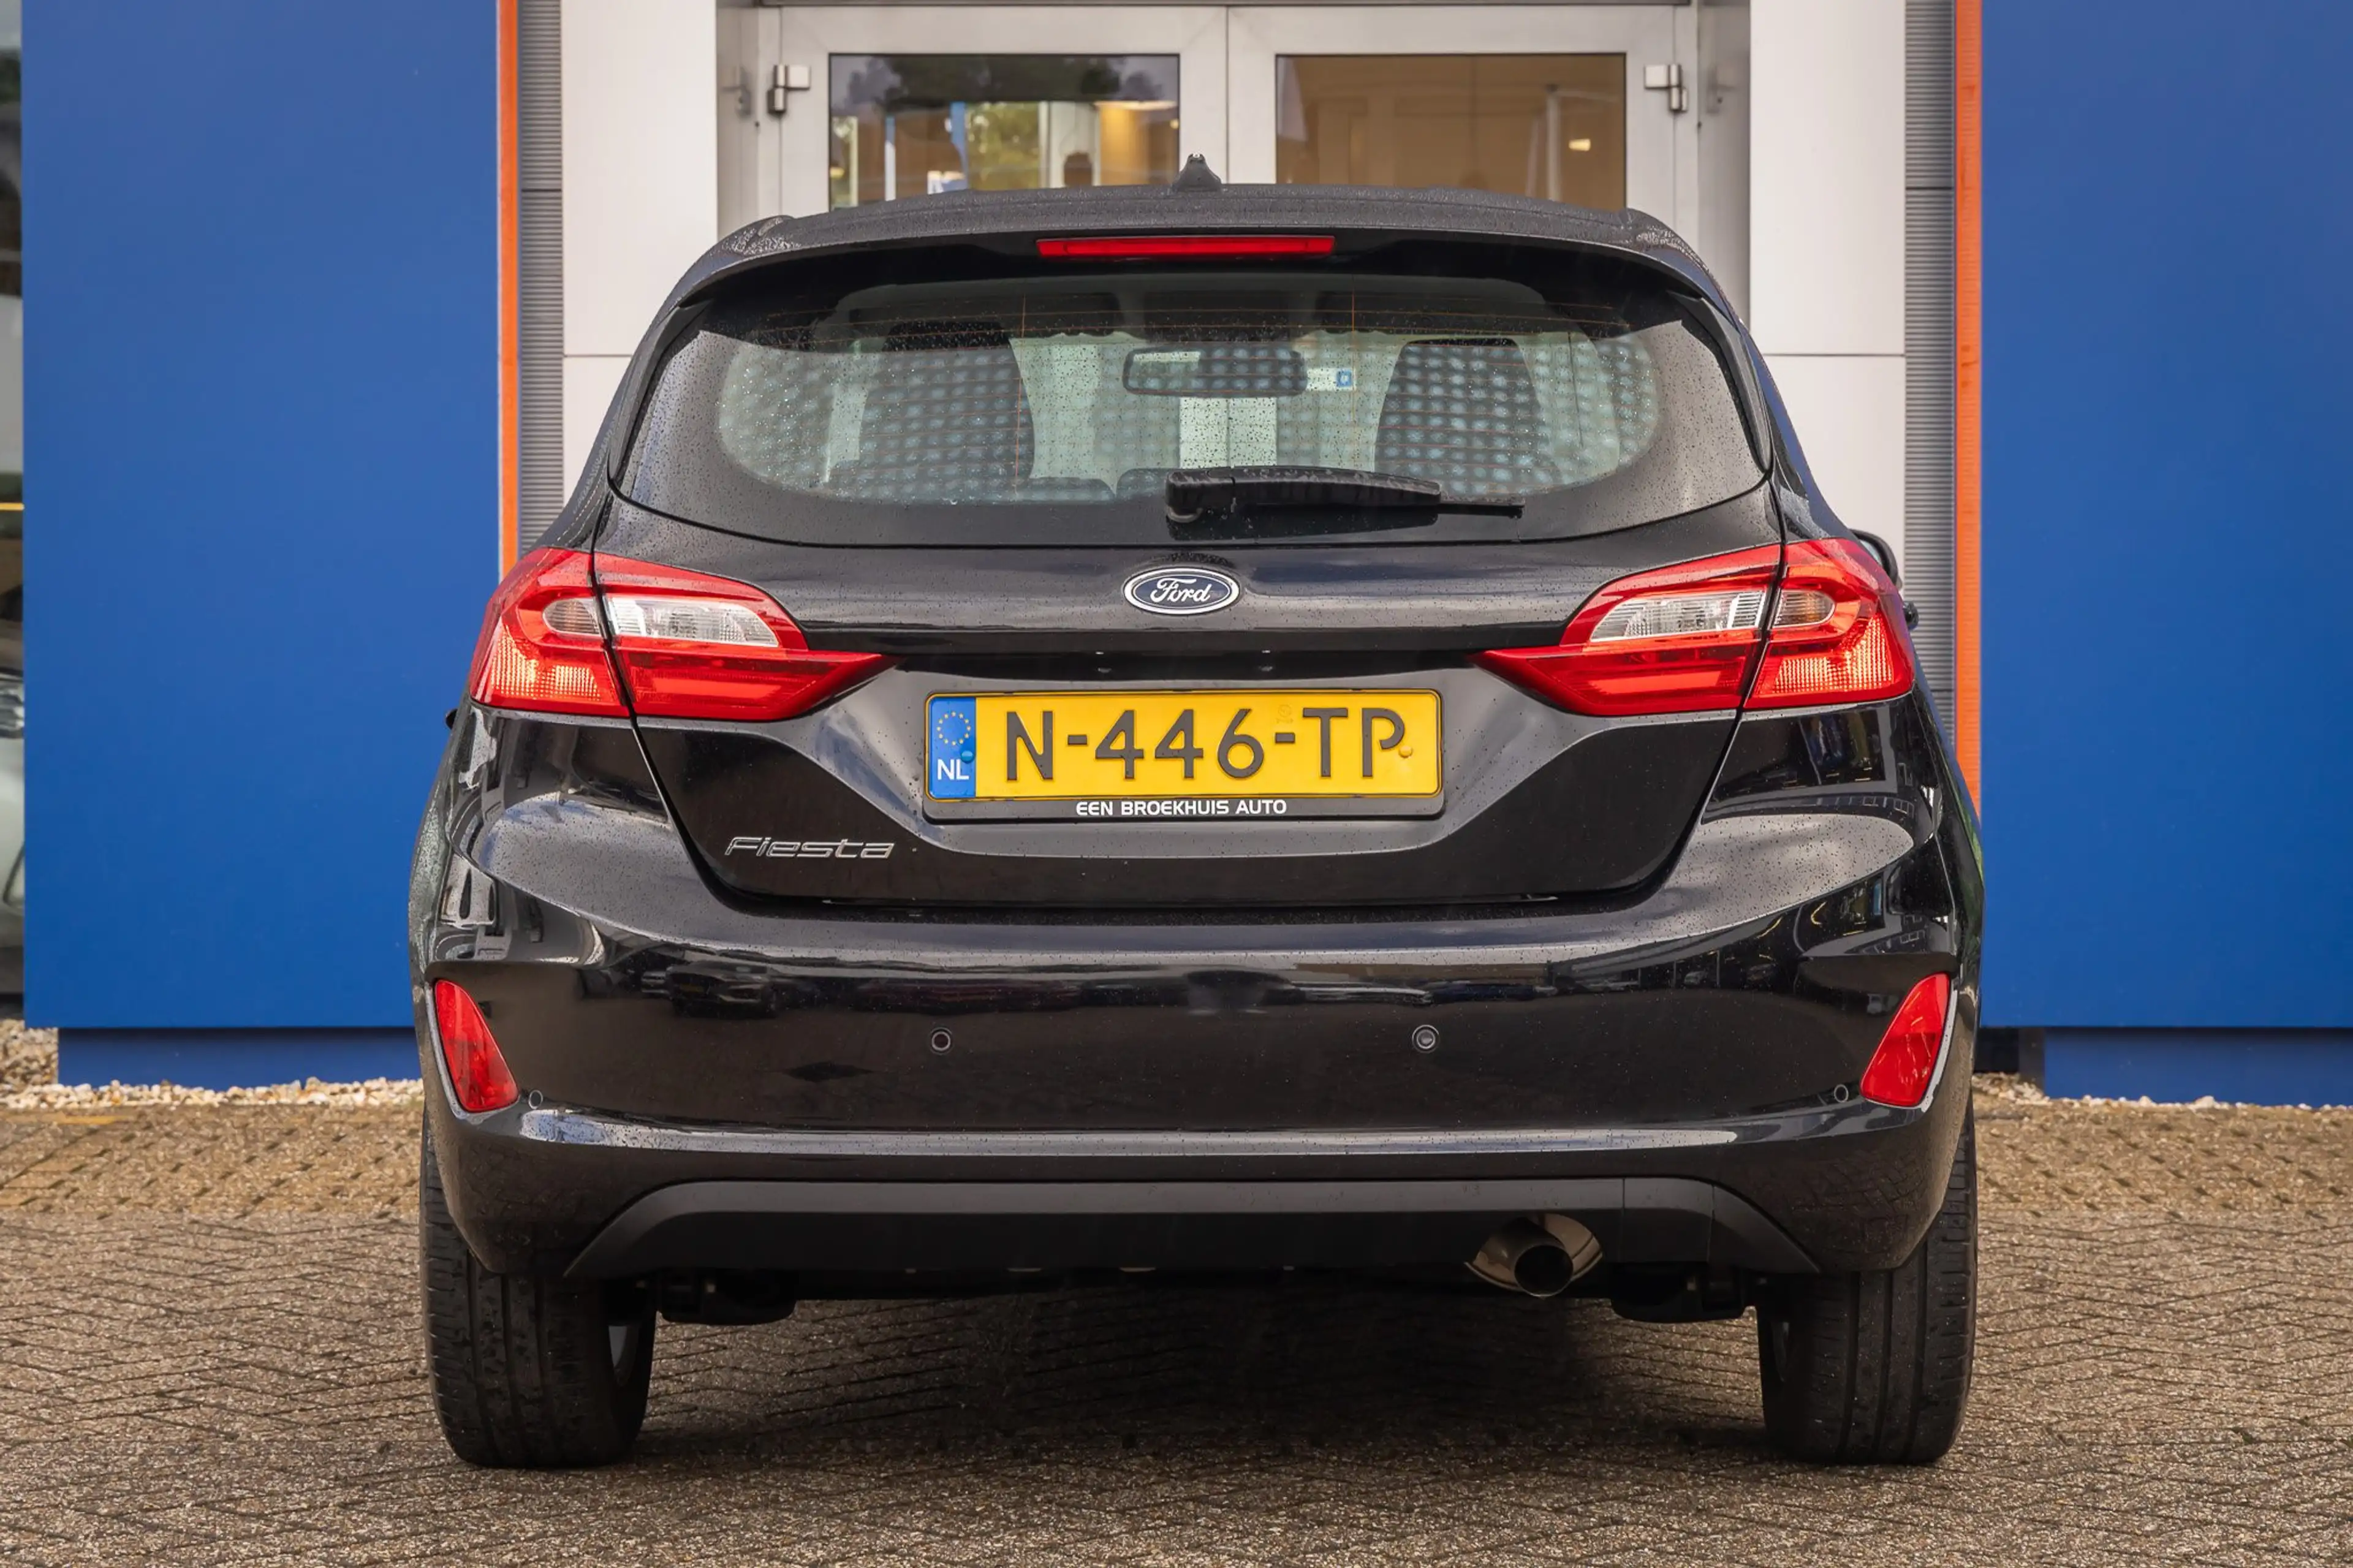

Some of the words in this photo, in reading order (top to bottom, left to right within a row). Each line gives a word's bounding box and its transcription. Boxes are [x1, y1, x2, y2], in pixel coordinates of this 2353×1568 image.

[1150, 577, 1213, 603] Ford
[1006, 707, 1406, 781] N-446-TP
[937, 759, 969, 781] NL
[1075, 800, 1113, 816] EEN
[1121, 799, 1229, 816] BROEKHUIS
[1235, 799, 1287, 815] AUTO
[724, 836, 895, 859] Fiesta
